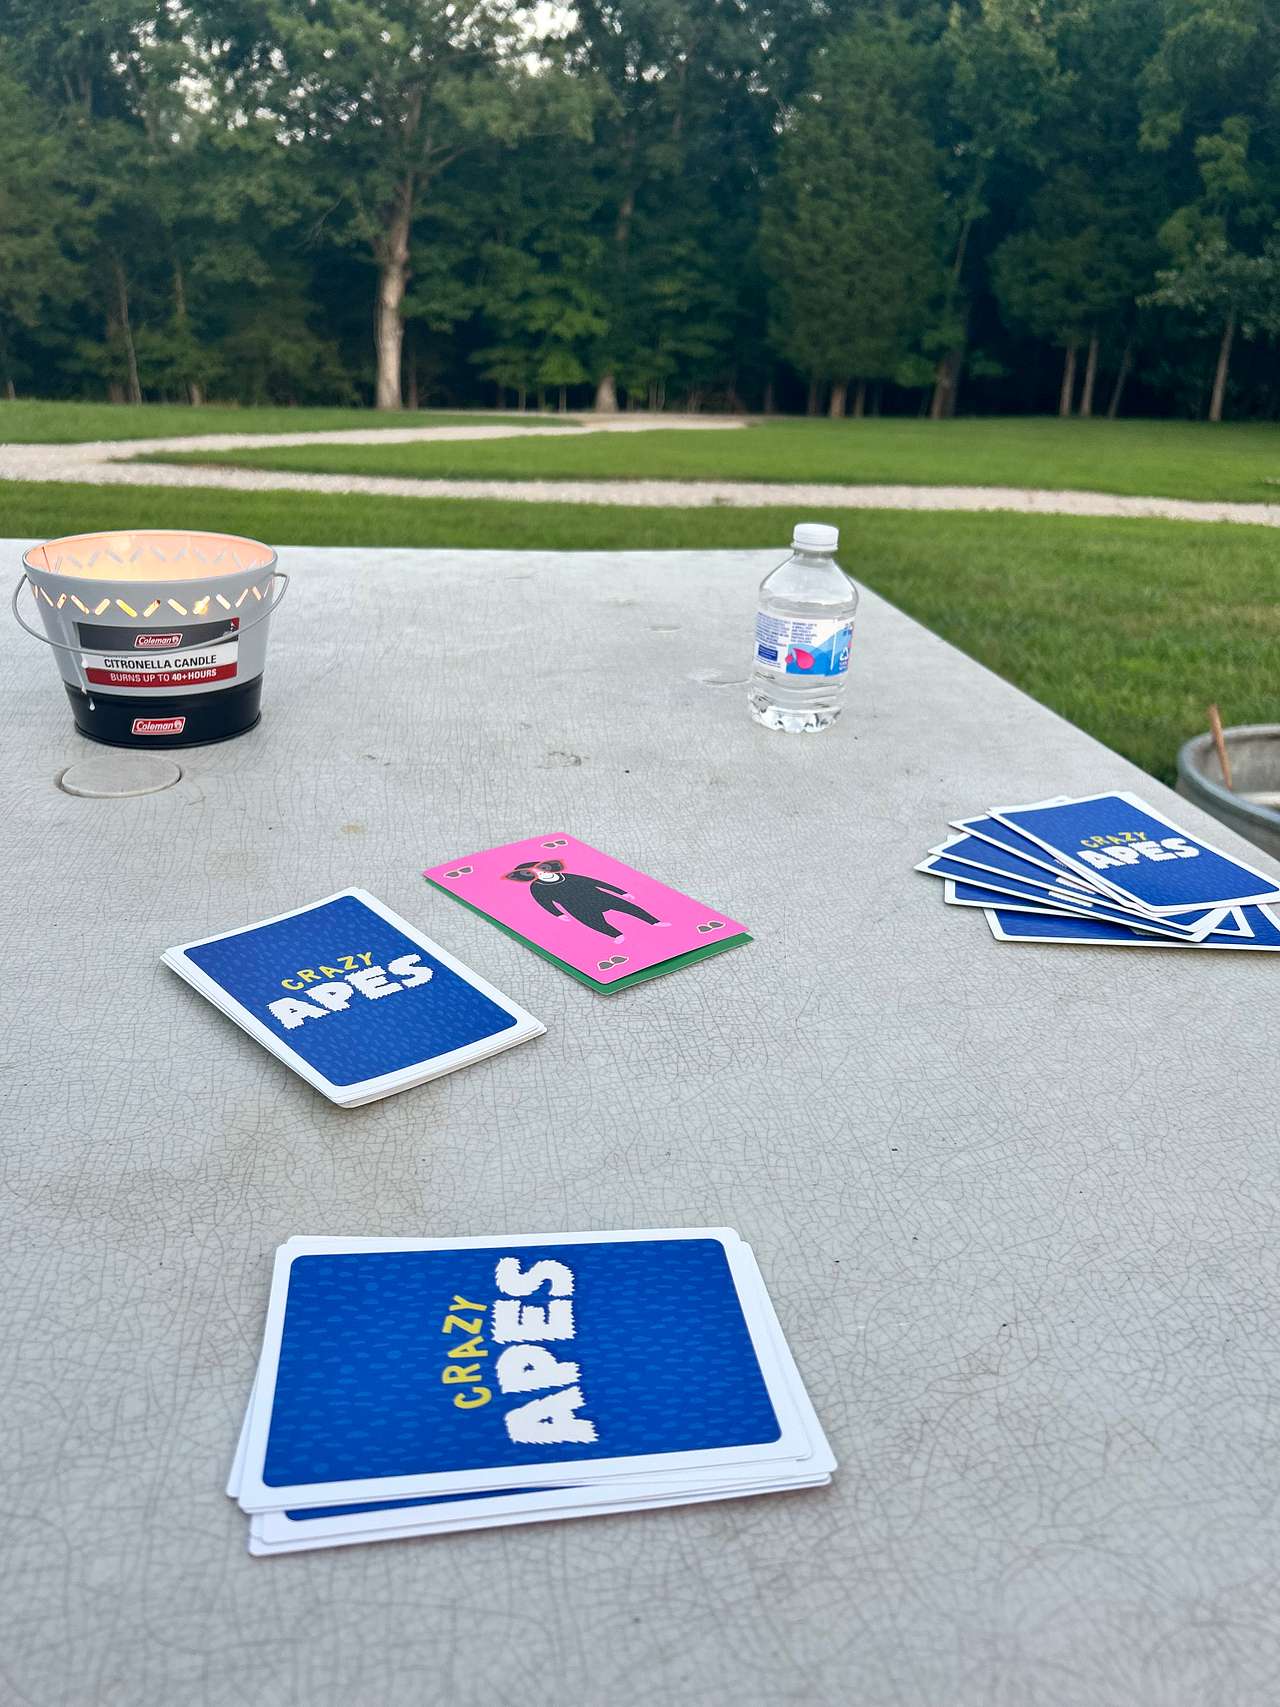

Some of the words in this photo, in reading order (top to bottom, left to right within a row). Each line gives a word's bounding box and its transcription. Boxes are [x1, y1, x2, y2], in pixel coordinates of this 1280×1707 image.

[137, 635, 173, 647] Coleman
[104, 657, 171, 670] CITRONELLA
[173, 655, 217, 669] CANDLE
[110, 672, 141, 683] BURNS
[143, 673, 156, 683] UP
[159, 672, 170, 682] TO
[135, 719, 175, 732] Coleman
[1080, 831, 1148, 848] CRAZY
[1076, 837, 1200, 869] APES
[281, 951, 373, 991] CRAZY
[266, 953, 435, 1030] APES
[441, 1294, 492, 1411] CRAZY
[491, 1256, 599, 1446] APES
